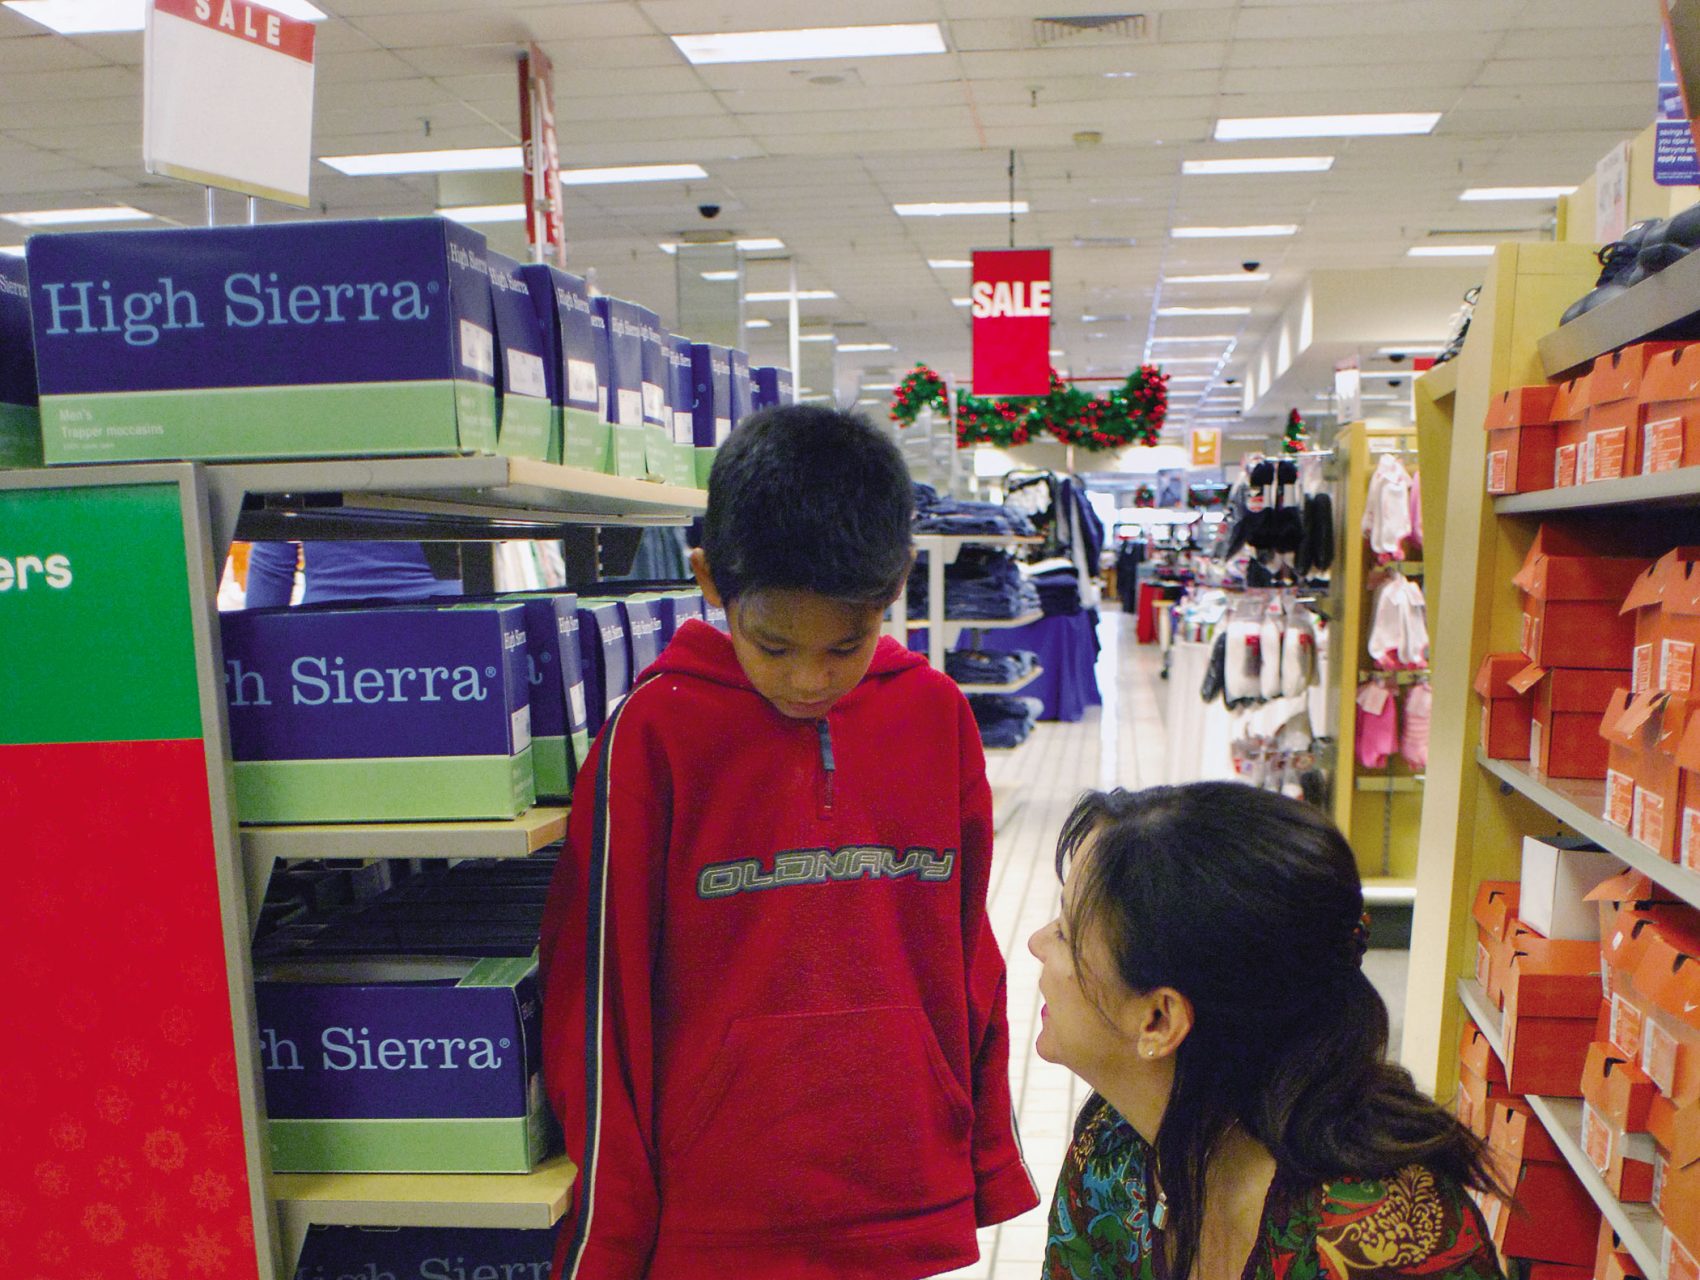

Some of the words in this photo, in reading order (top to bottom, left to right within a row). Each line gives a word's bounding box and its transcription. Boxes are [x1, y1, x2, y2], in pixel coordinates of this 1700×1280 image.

[195, 0, 281, 46] SALE
[42, 278, 203, 346] High
[972, 280, 1051, 319] SALE
